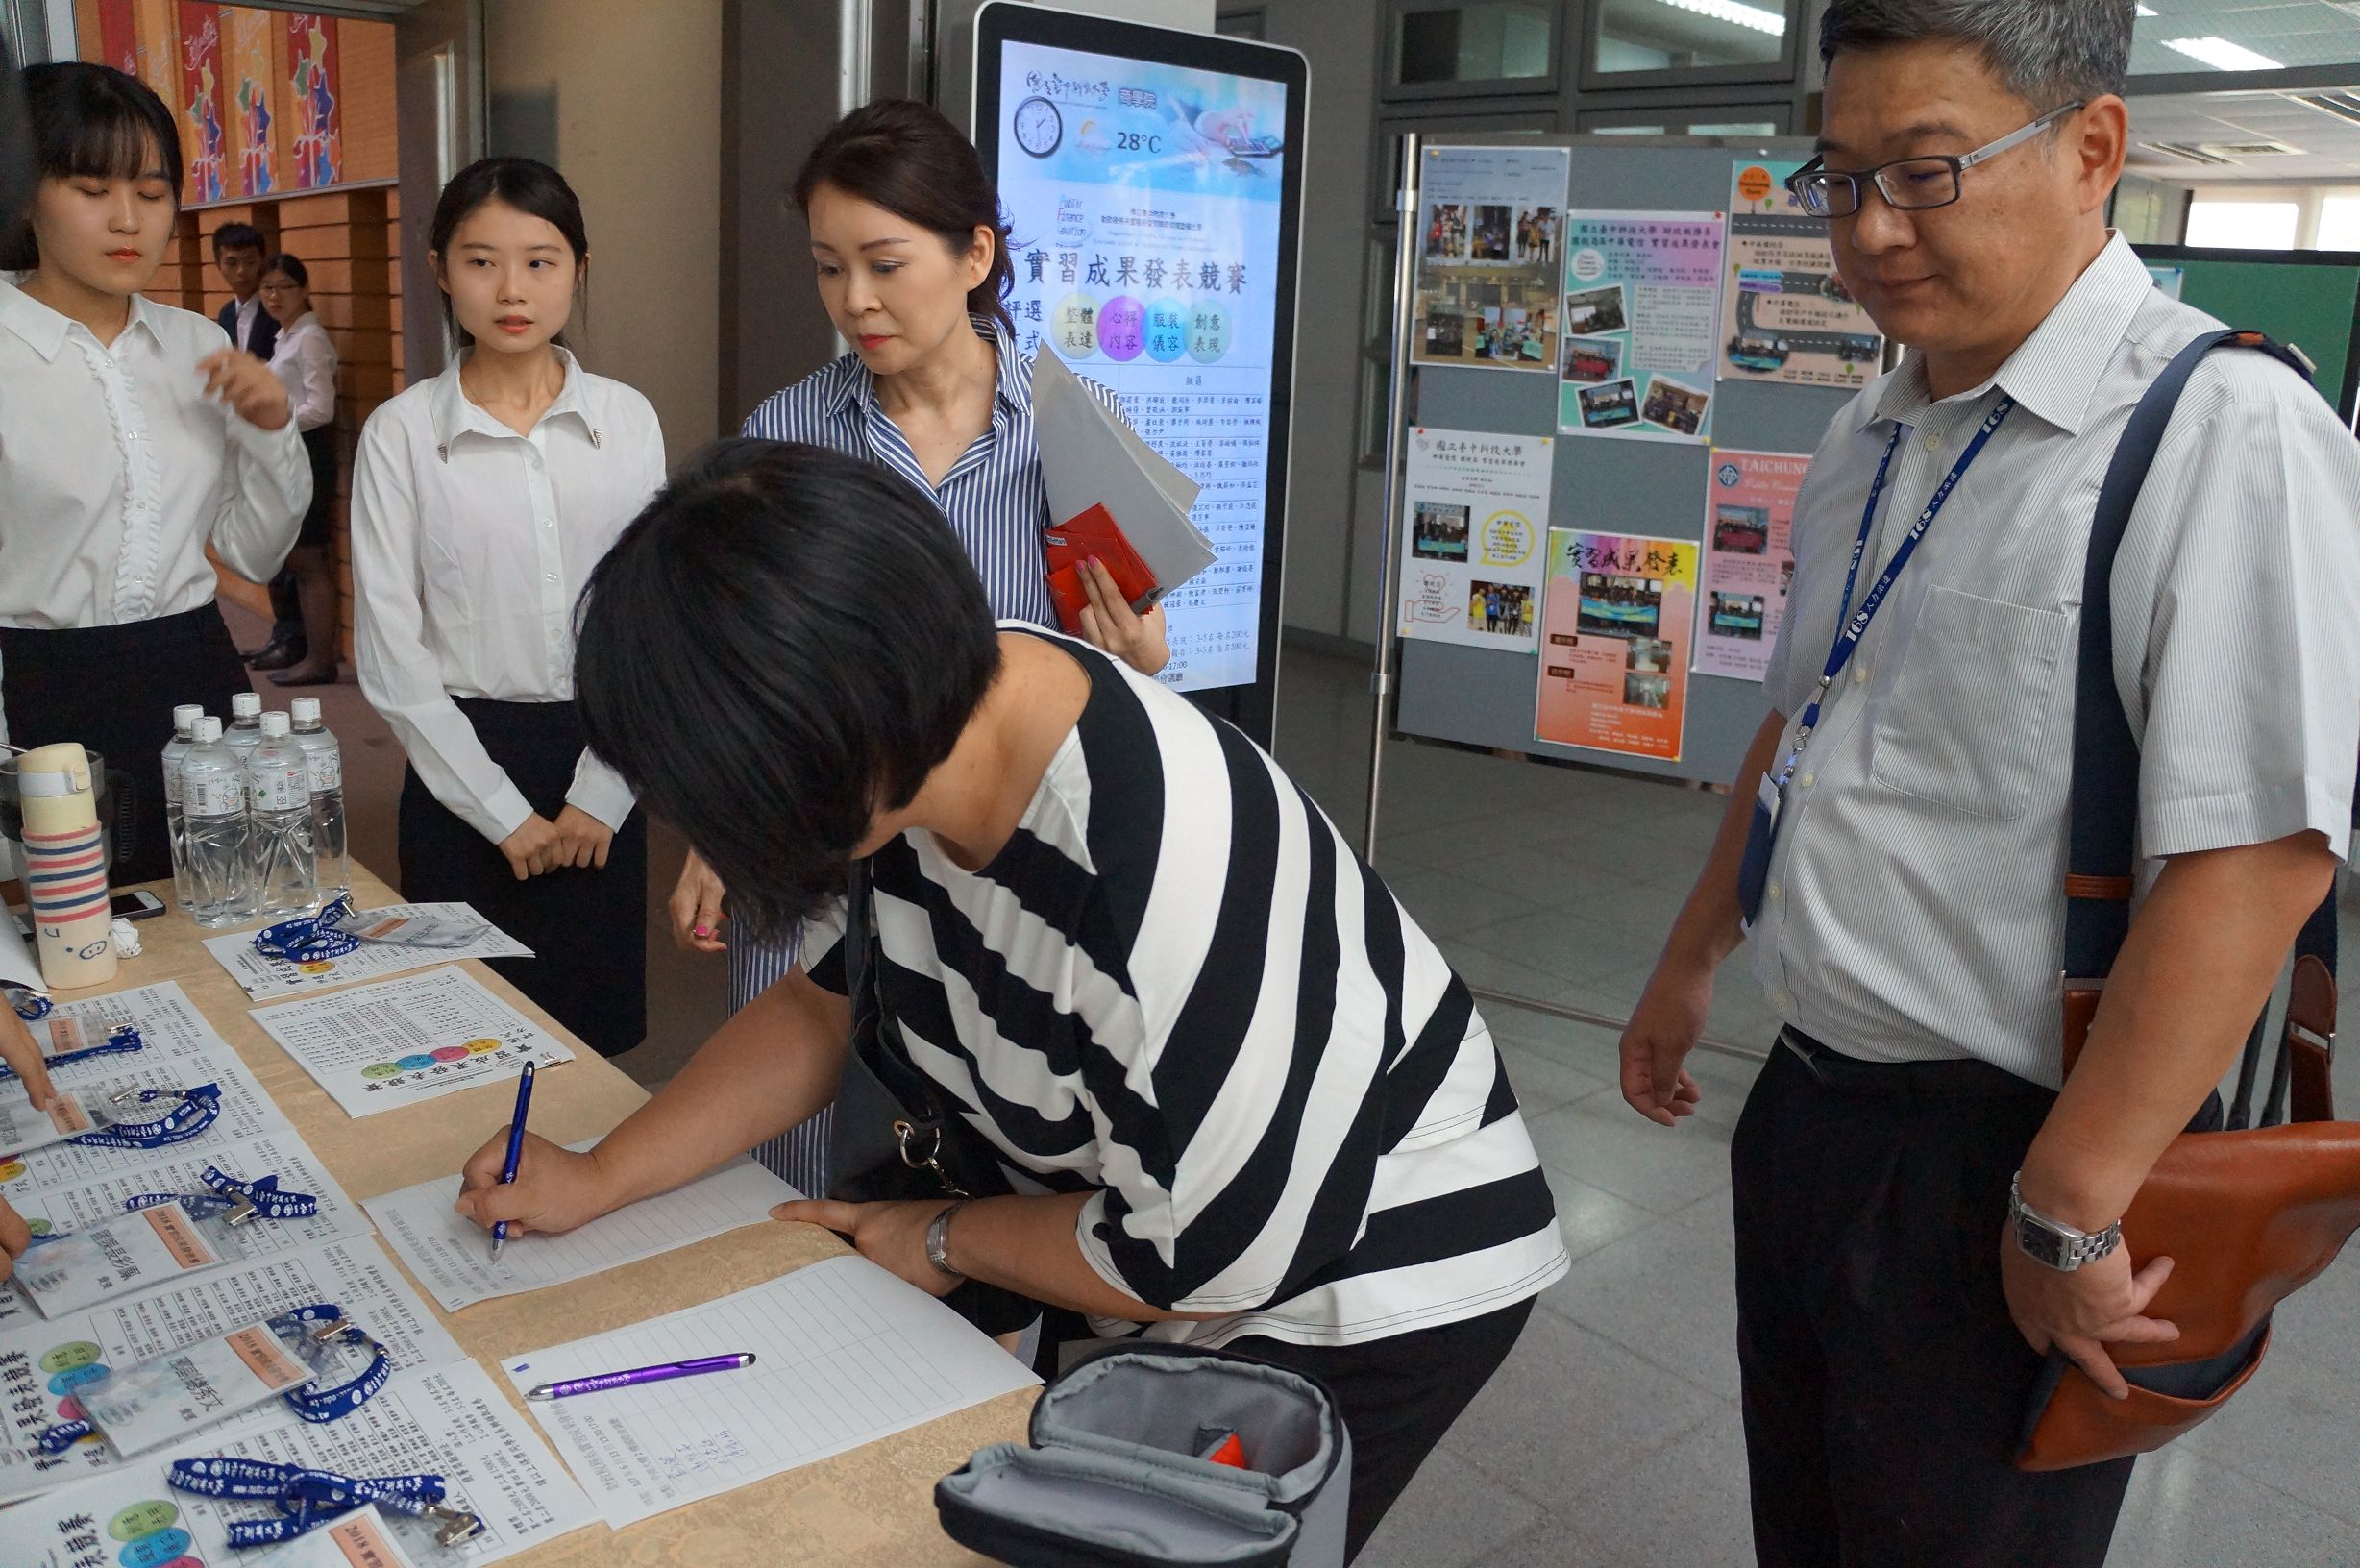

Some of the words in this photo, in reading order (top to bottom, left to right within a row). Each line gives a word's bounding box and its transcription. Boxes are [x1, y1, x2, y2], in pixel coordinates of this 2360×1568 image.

[1024, 249, 1248, 295] 實習成果發表競賽
[1982, 400, 2009, 434] 168
[1909, 507, 1933, 541] 168
[1845, 609, 1870, 643] 168
